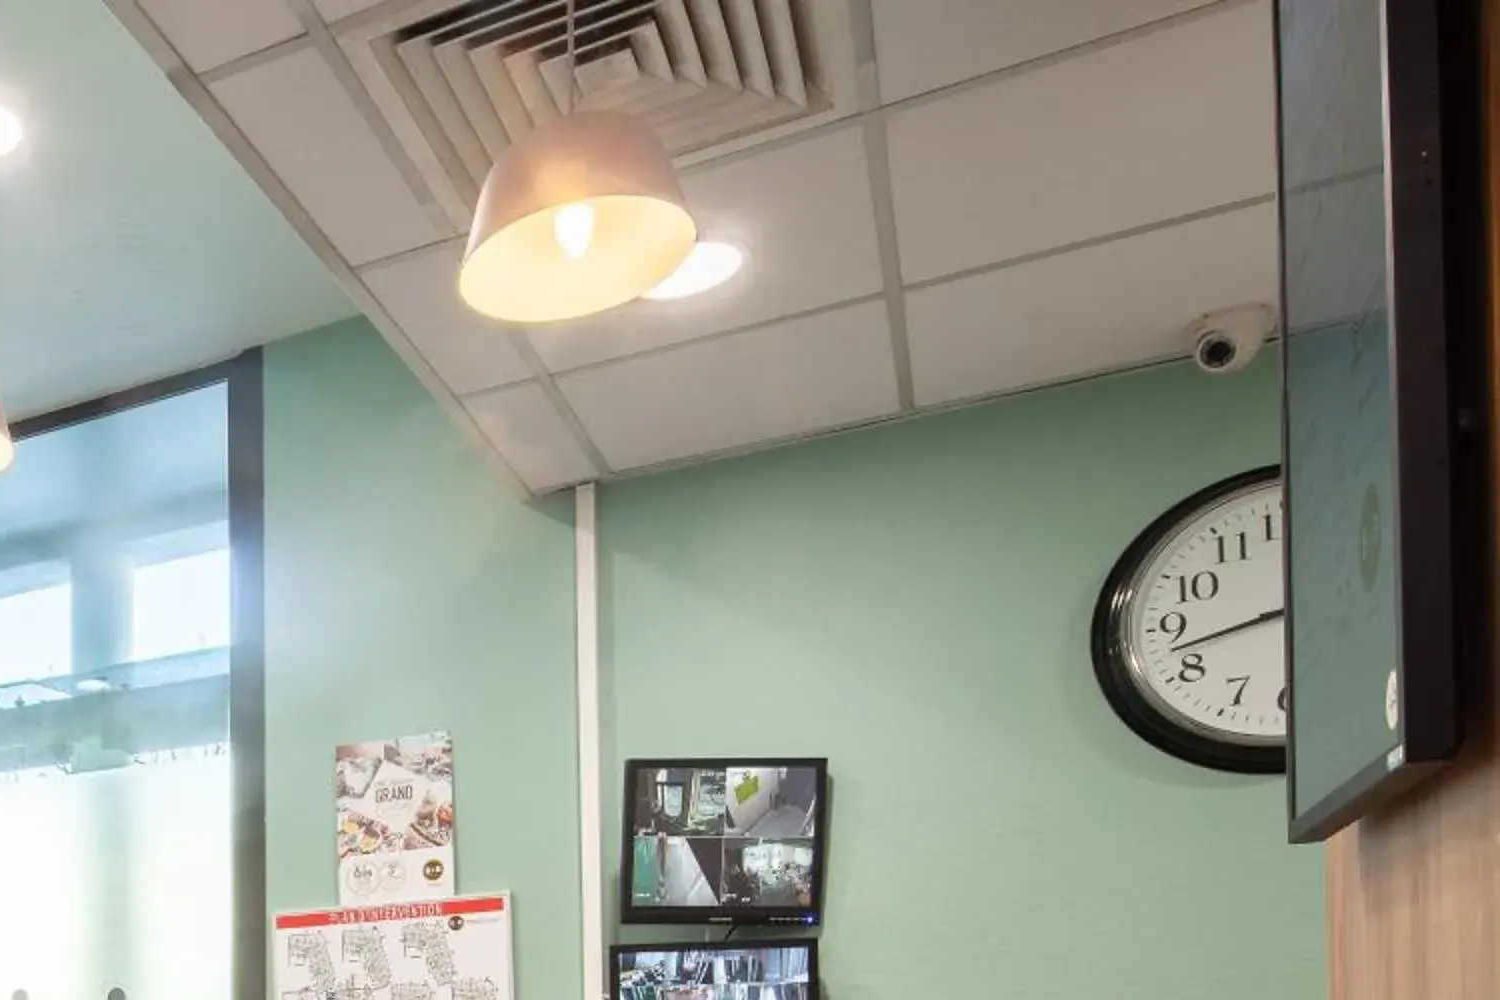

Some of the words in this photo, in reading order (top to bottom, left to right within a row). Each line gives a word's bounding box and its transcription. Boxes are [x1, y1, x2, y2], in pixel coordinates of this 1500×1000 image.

[1262, 513, 1281, 542] 1
[1214, 531, 1251, 564] 11
[1175, 570, 1220, 605] 10
[1159, 611, 1188, 643] 9
[1178, 653, 1206, 683] 8
[1226, 674, 1251, 707] 7
[375, 783, 413, 803] GRAND
